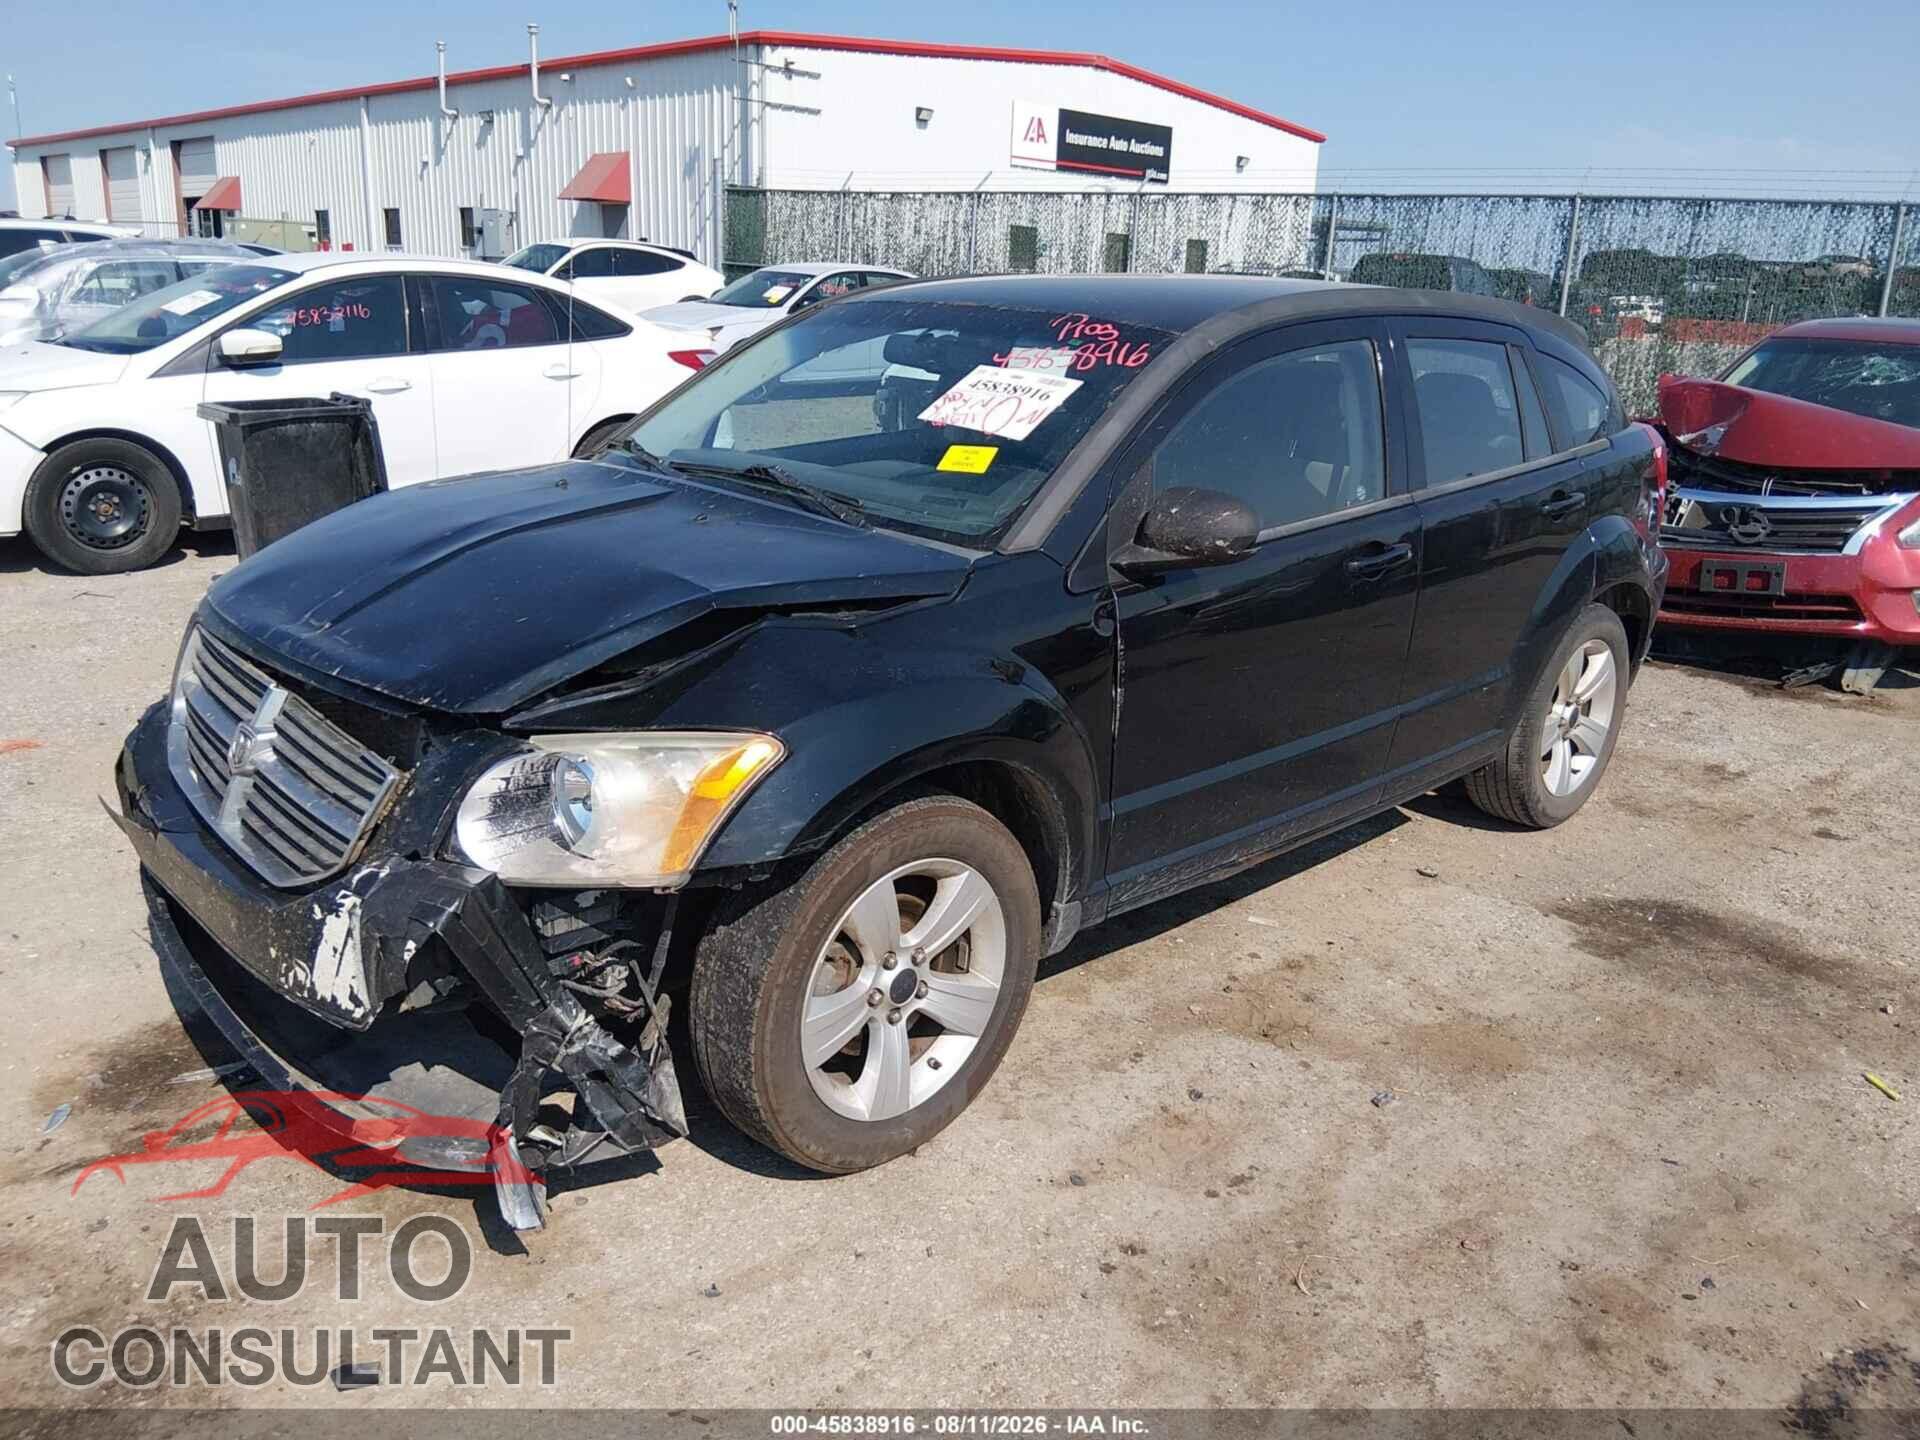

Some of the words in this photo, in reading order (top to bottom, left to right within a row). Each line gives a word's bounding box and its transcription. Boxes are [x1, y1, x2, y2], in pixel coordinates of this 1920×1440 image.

[1066, 128, 1108, 149] Insurance
[1109, 136, 1128, 152] Auto
[1129, 138, 1164, 157] Auctions
[969, 380, 1051, 401] 45838916
